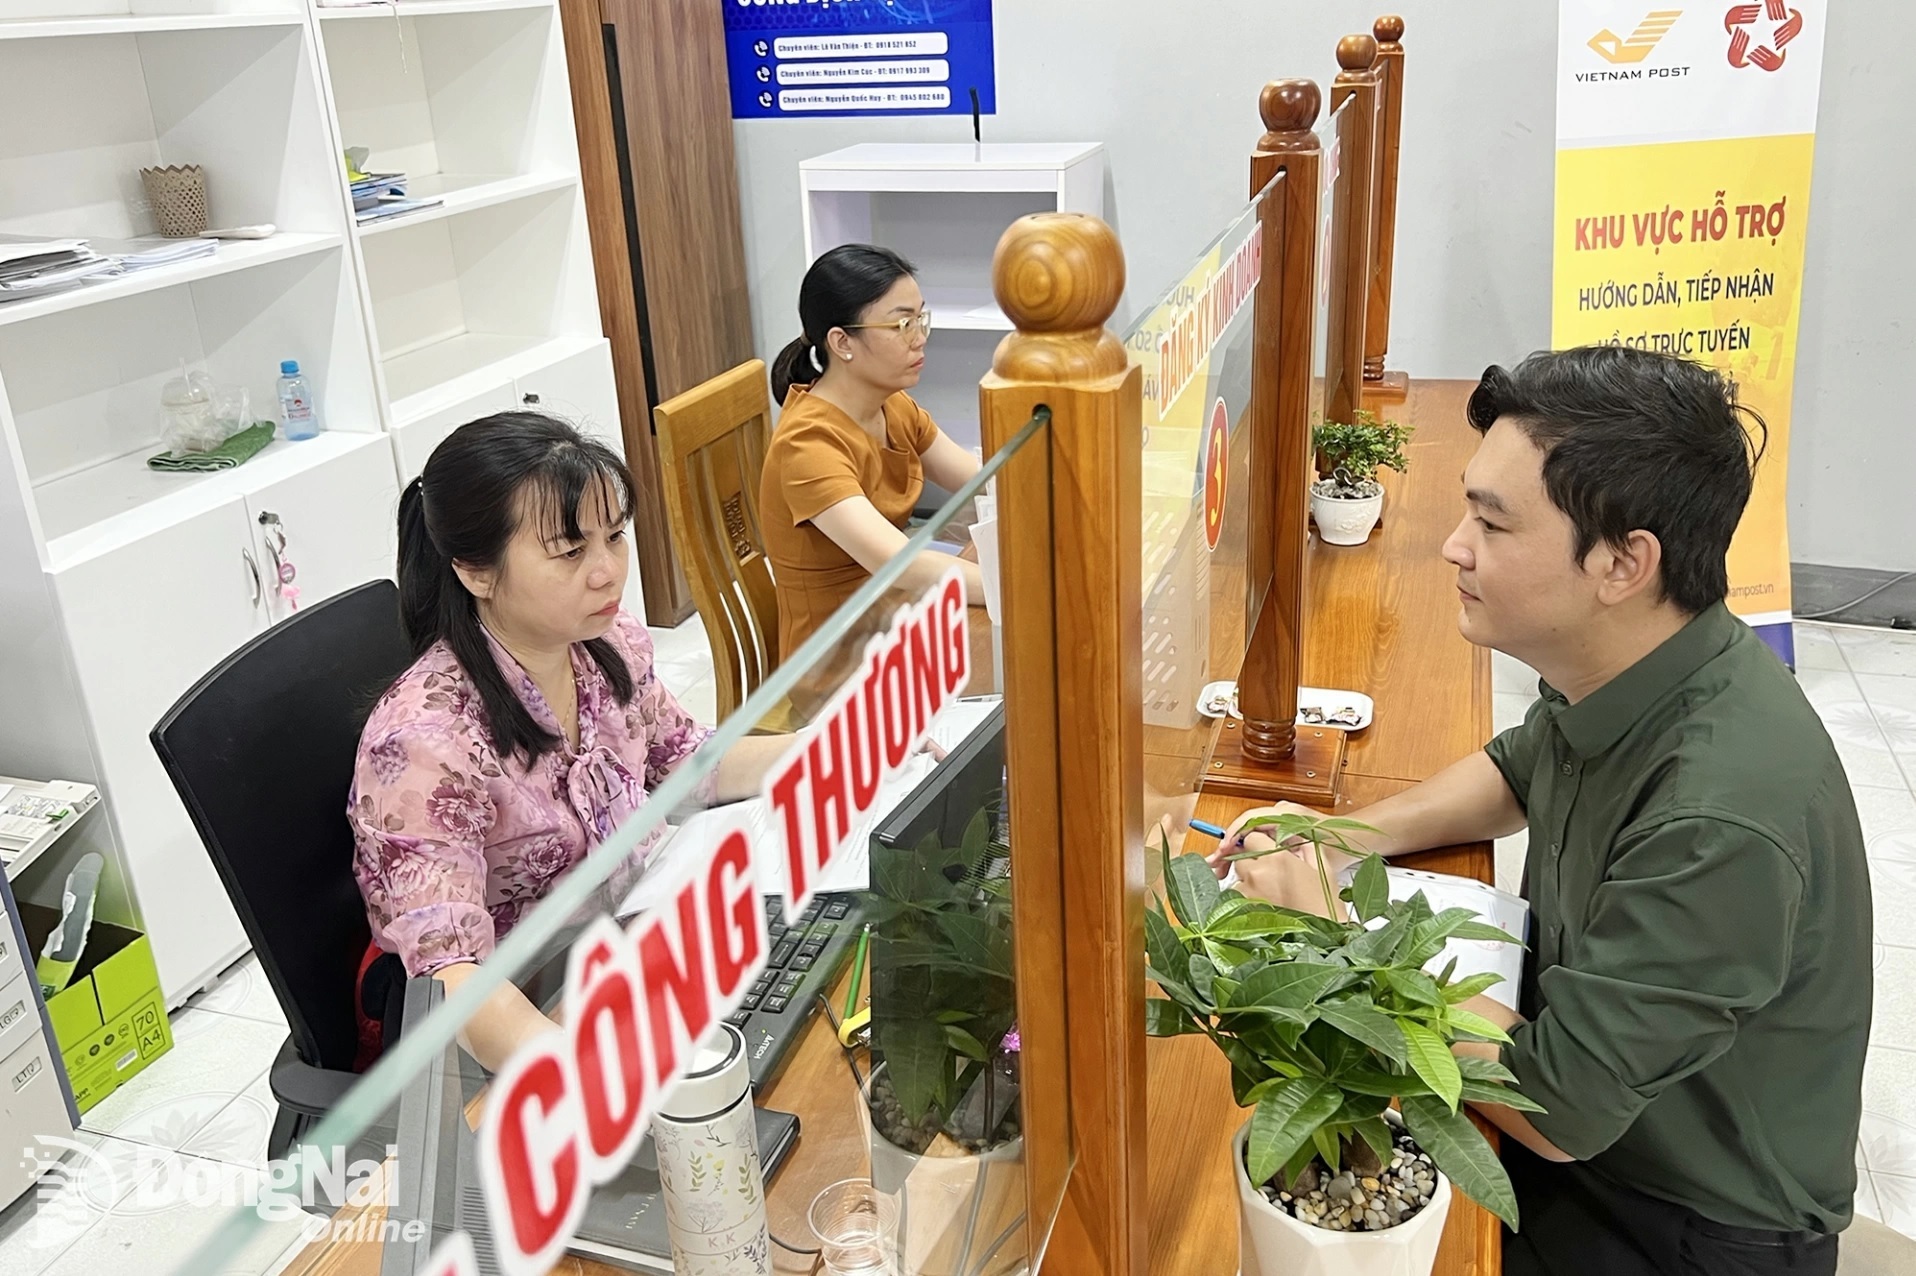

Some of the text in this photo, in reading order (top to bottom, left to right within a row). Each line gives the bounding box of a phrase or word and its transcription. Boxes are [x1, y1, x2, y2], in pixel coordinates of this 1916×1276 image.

[780, 70, 804, 78] Chuyên
[848, 68, 860, 76] Kim
[1575, 67, 1691, 82] VIETNAM POST
[782, 96, 806, 104] Chuyên
[1575, 190, 1786, 255] KHU VỰC HỖ TRỢ
[1579, 268, 1774, 311] HƯỚNG DẪN, TIẾP NHẬN
[1160, 310, 1195, 415] ĐĂNG
[1212, 257, 1235, 344] KINH
[1698, 319, 1750, 353] TUYẾN
[493, 577, 965, 1260] CÔNG THƯƠNG
[136, 1010, 154, 1030] 70
[142, 1029, 161, 1051] A4
